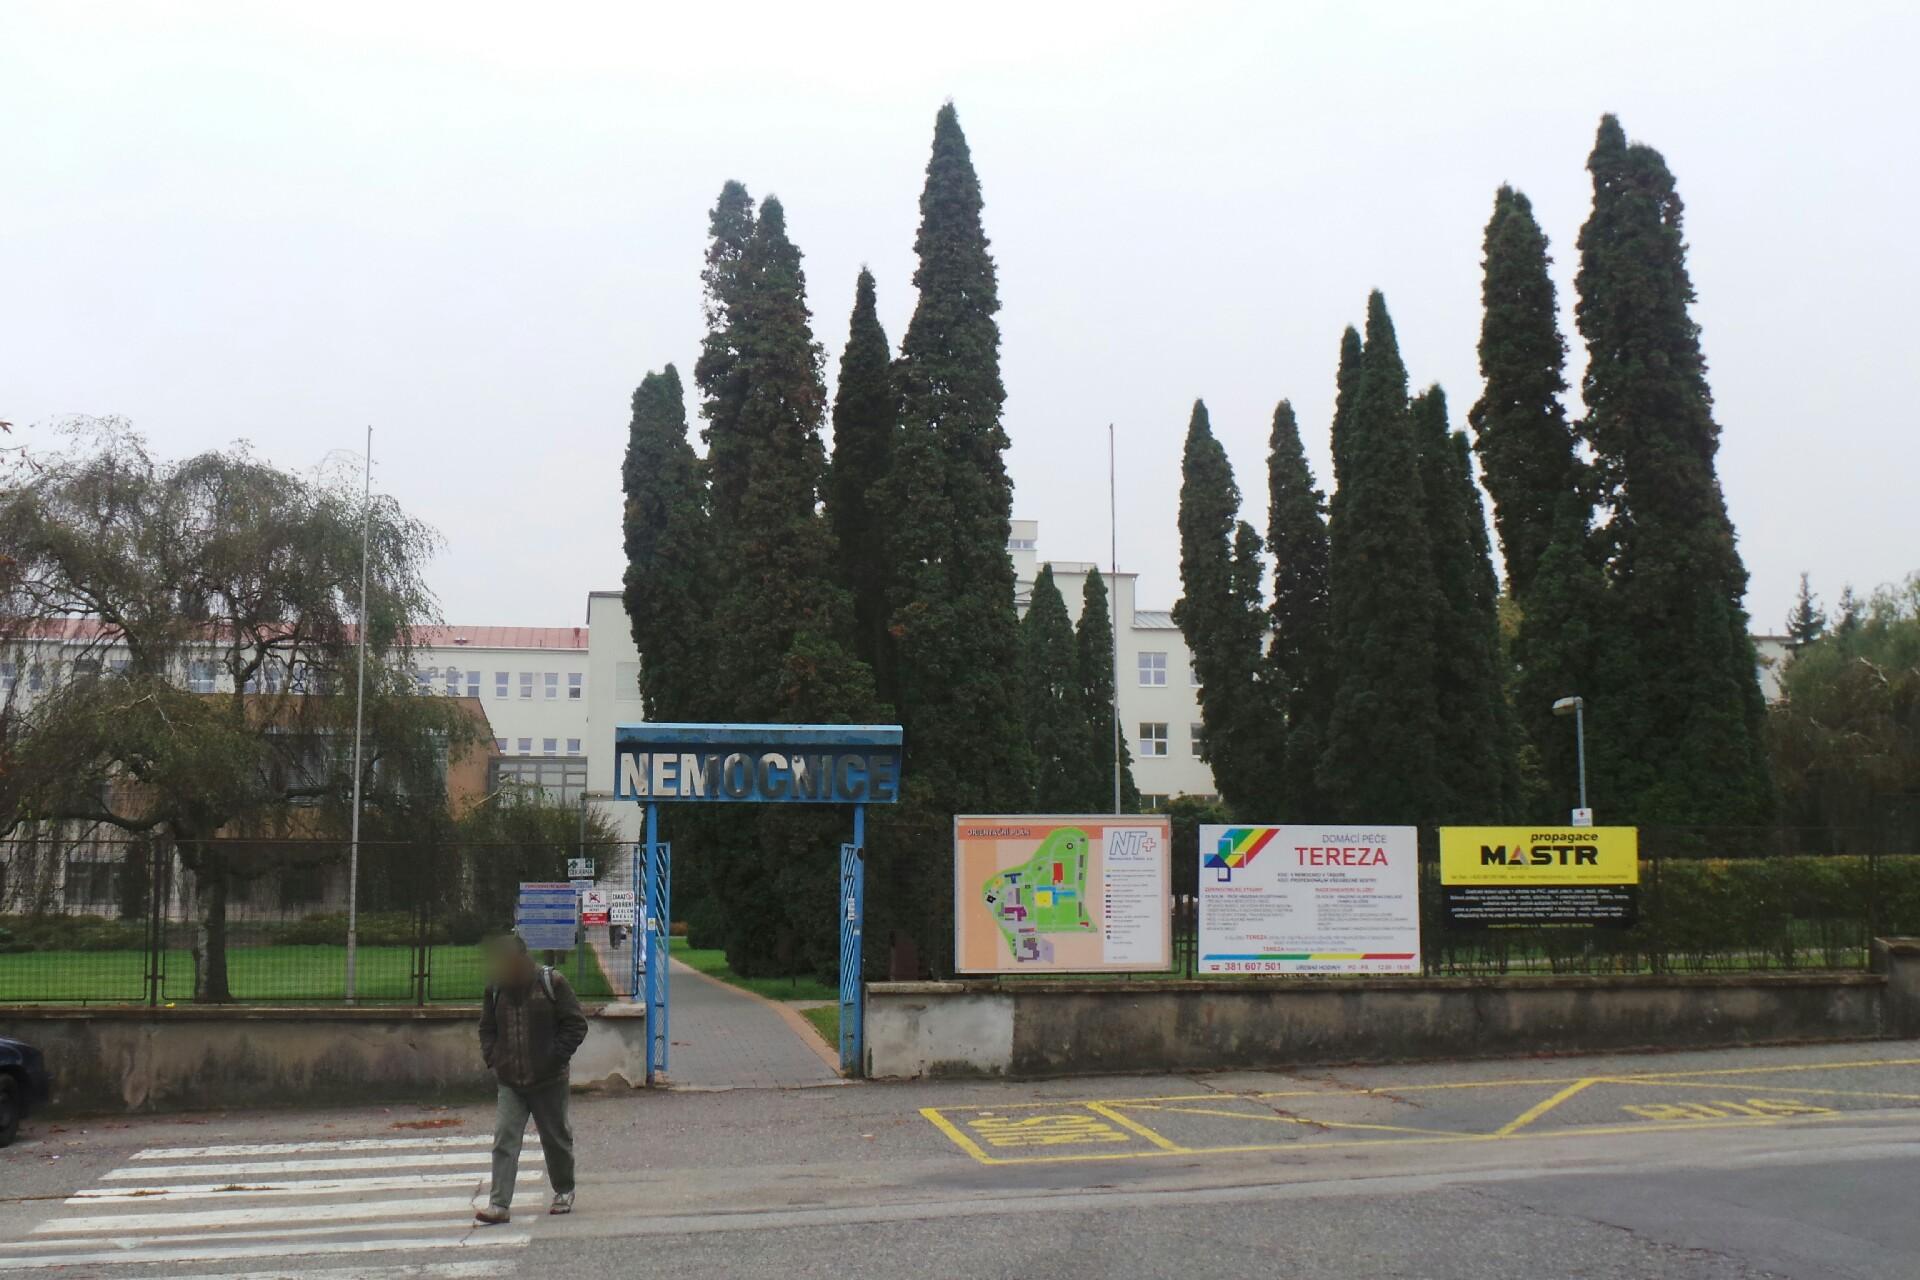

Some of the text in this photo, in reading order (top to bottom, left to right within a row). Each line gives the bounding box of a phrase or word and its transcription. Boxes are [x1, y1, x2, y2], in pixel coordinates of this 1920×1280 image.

[620, 752, 895, 799] NEMOCNICE
[1531, 833, 1598, 843] propagace
[1294, 847, 1389, 866] TEREZA
[1481, 845, 1598, 866] MASTR
[1225, 962, 1281, 970] 381 607 501
